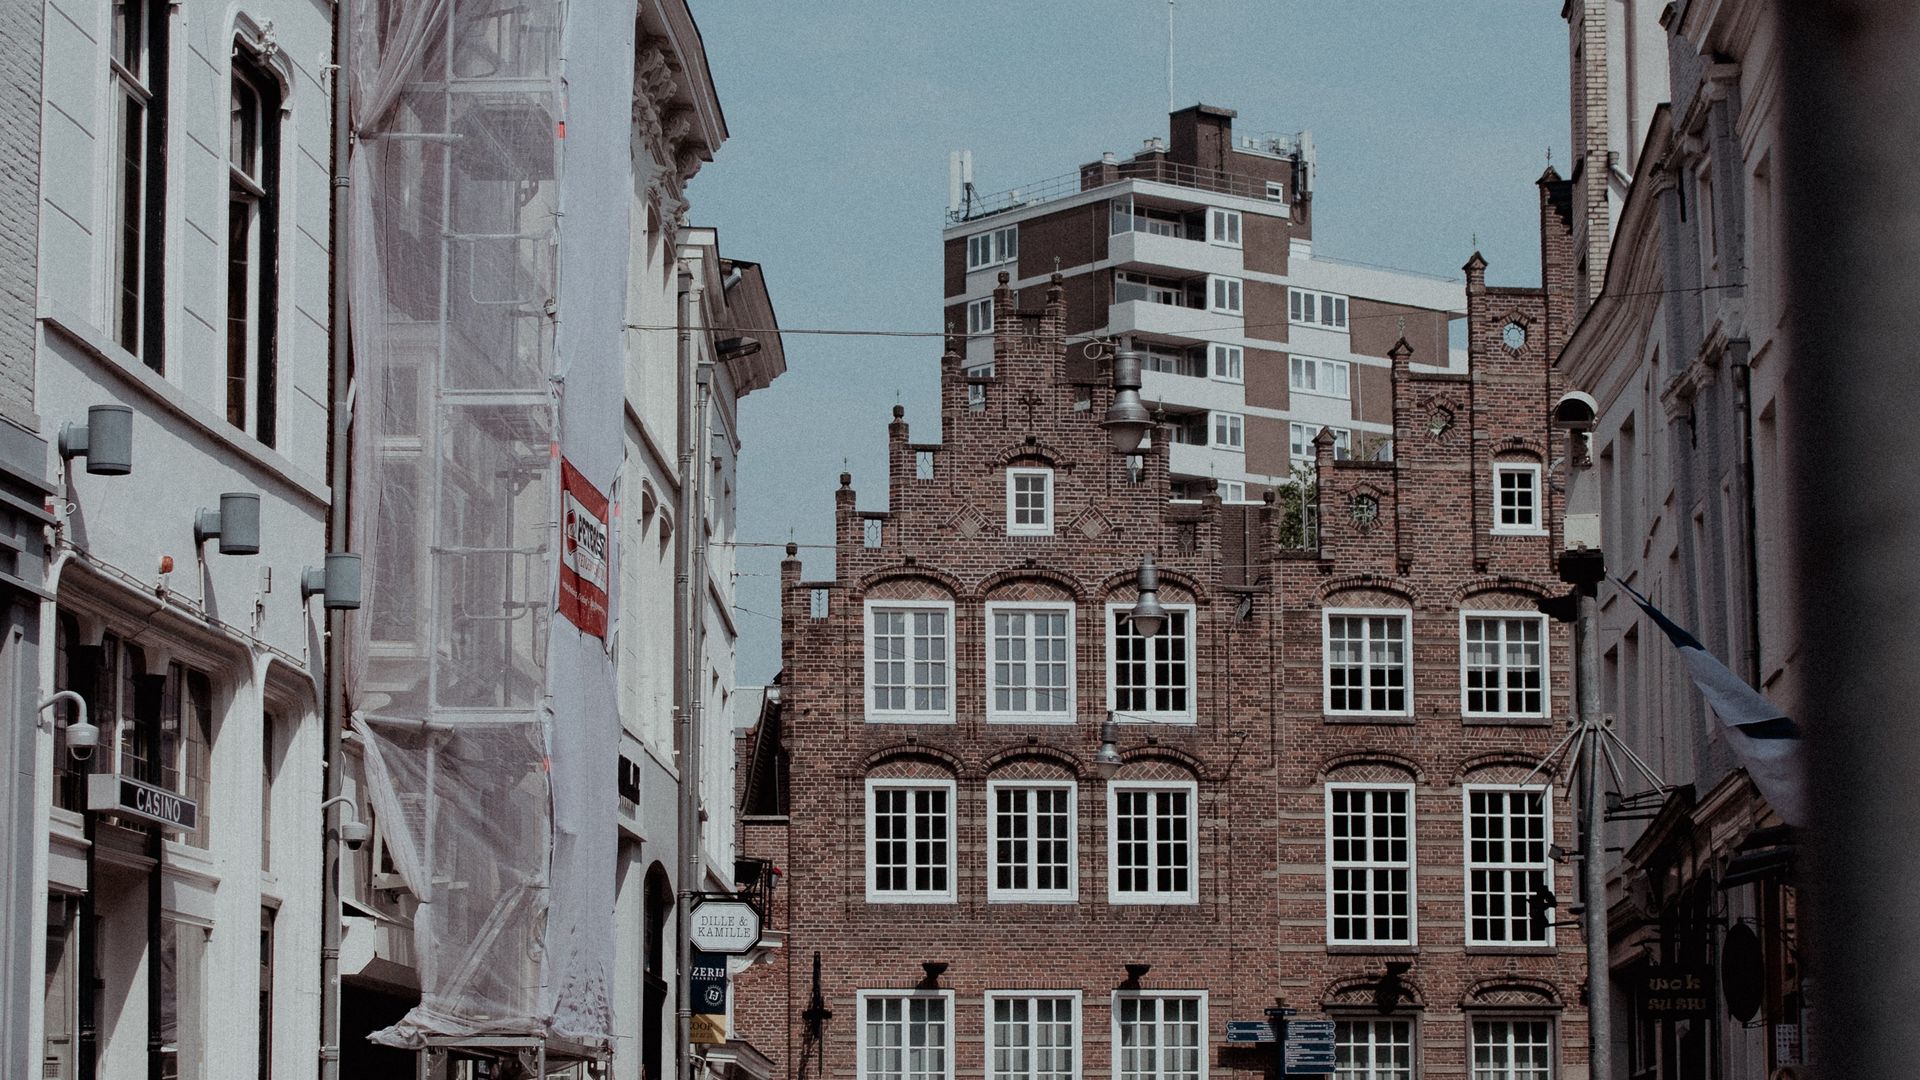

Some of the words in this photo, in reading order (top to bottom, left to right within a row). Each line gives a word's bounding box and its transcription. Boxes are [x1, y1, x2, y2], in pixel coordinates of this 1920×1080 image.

[136, 787, 181, 822] CASINO
[701, 915, 735, 927] DILLE
[739, 916, 748, 927] &
[698, 927, 751, 938] KAMILLE
